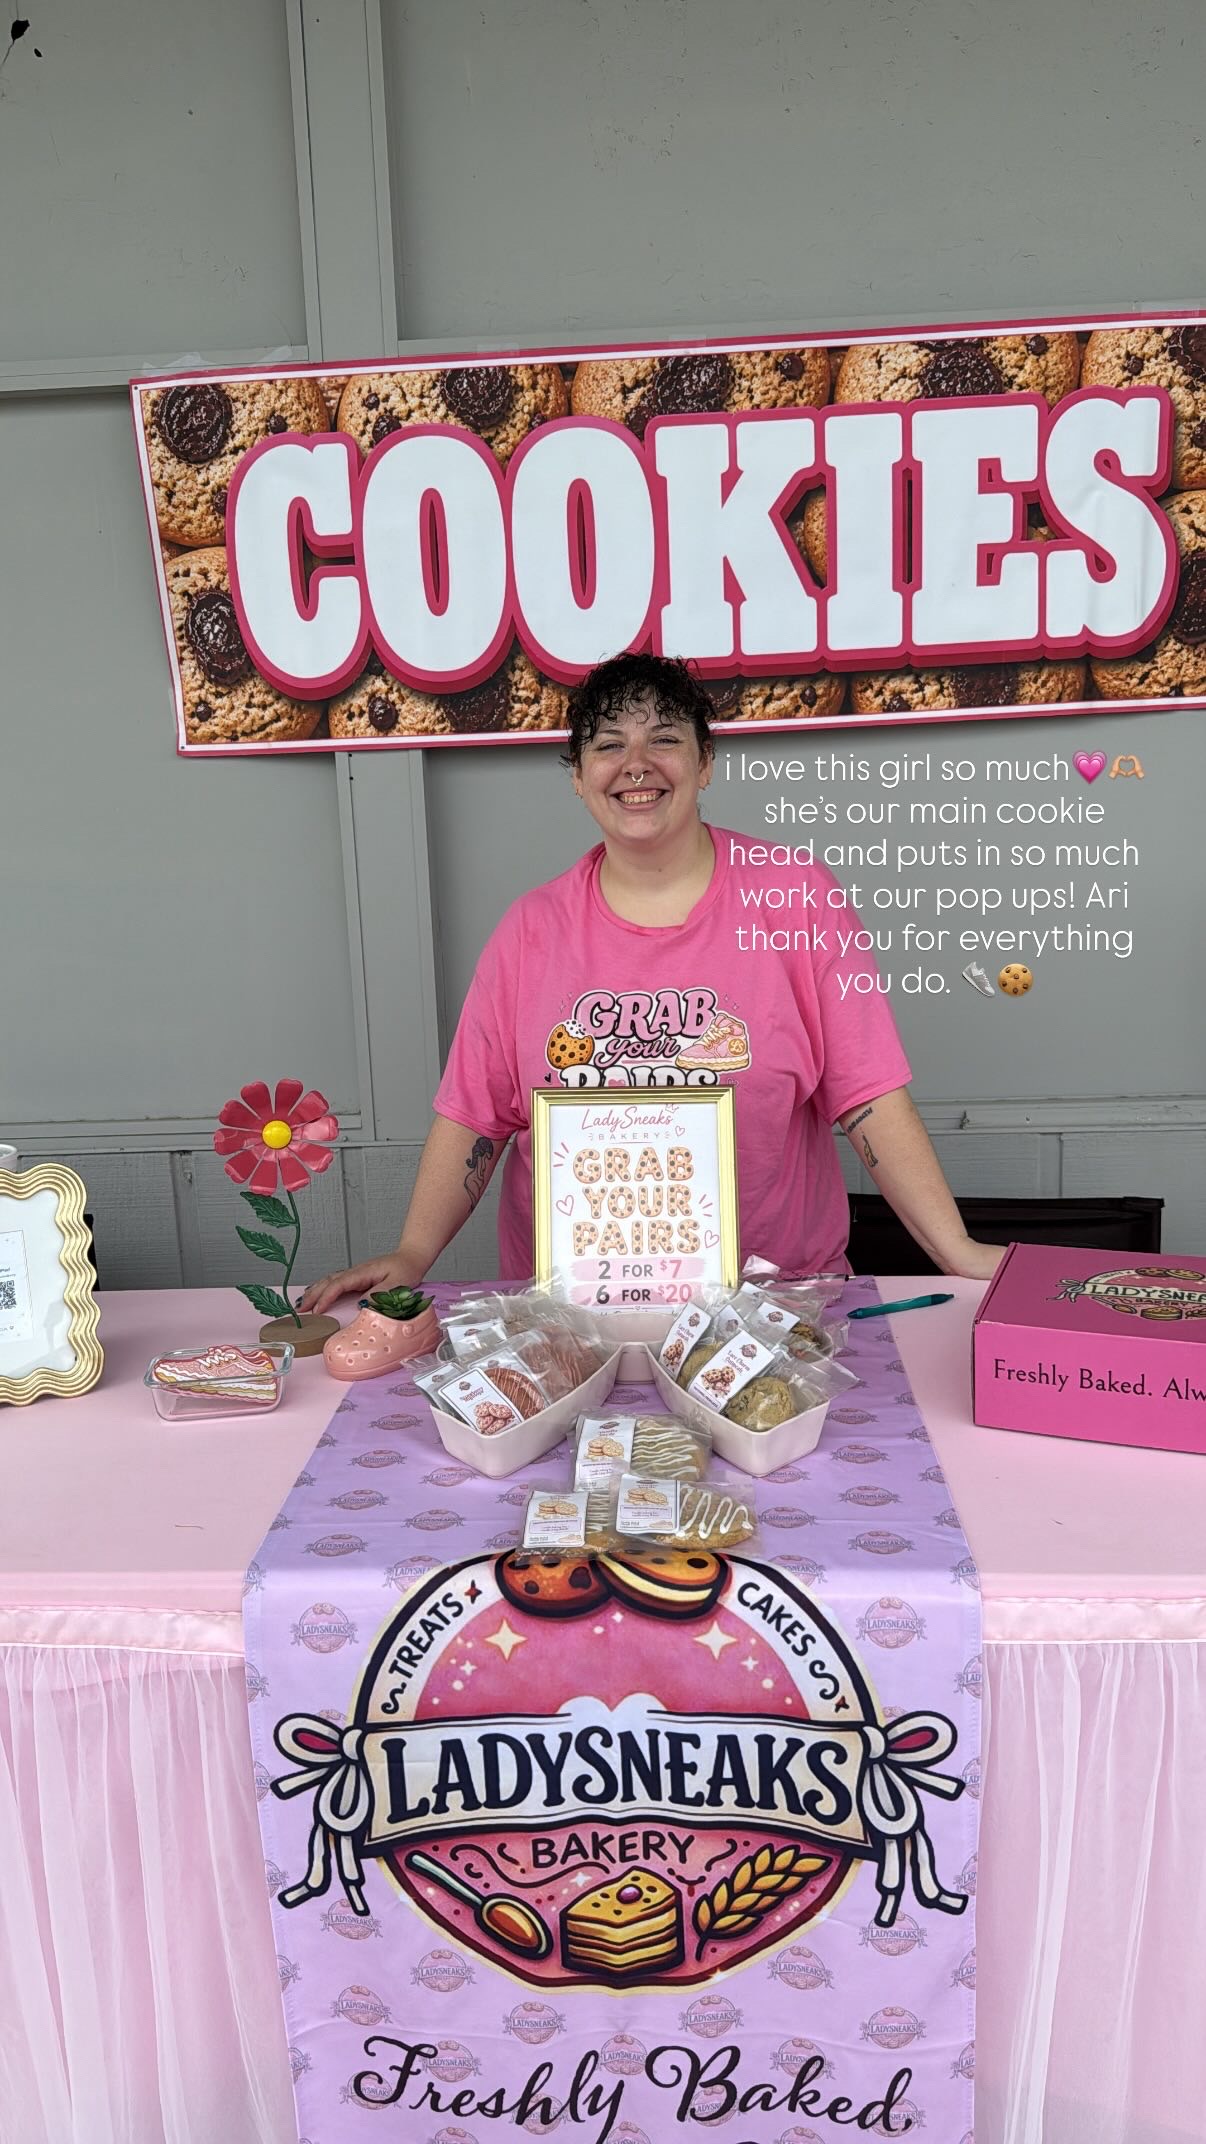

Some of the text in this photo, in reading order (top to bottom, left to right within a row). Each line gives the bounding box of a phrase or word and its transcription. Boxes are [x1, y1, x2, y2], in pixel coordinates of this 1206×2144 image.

[230, 387, 1177, 692] COOKIES
[574, 988, 716, 1042] GRAB
[594, 1037, 681, 1069] your
[581, 1105, 674, 1133] LadySneaks
[598, 1132, 660, 1141] BAKERY
[572, 1146, 695, 1184] GRAB
[582, 1183, 693, 1219] YOUR
[572, 1219, 701, 1256] PAIRS
[598, 1259, 682, 1280] 2 FOR $7
[595, 1283, 693, 1305] 6 FOR $20
[993, 1358, 1070, 1393] Freshly
[1079, 1367, 1153, 1397] Baked.
[301, 1624, 348, 1635] LADYSNEAKS
[736, 1580, 816, 1657] CAKES
[867, 1619, 916, 1630] LADYSNEAKS
[388, 1592, 464, 1679] TREATS
[380, 1725, 854, 1825] LADYSNEAKS
[531, 1830, 697, 1868] BAKERY
[870, 1929, 918, 1939] LADYSNEAKS
[420, 1967, 466, 1977] LADYSNEAKS
[778, 1963, 824, 1978] LADYSNEAKS
[340, 2000, 384, 2014] LADYSNEAKS
[688, 2011, 735, 2023] LADYSNEAKS
[512, 2018, 557, 2028] LADYSNEAKS
[870, 2024, 917, 2034] LADYSNEAKS
[428, 2057, 473, 2068] LADYSNEAKS
[603, 2051, 647, 2063] LADYSNEAKS
[353, 2035, 913, 2144] Freshly Baked,
